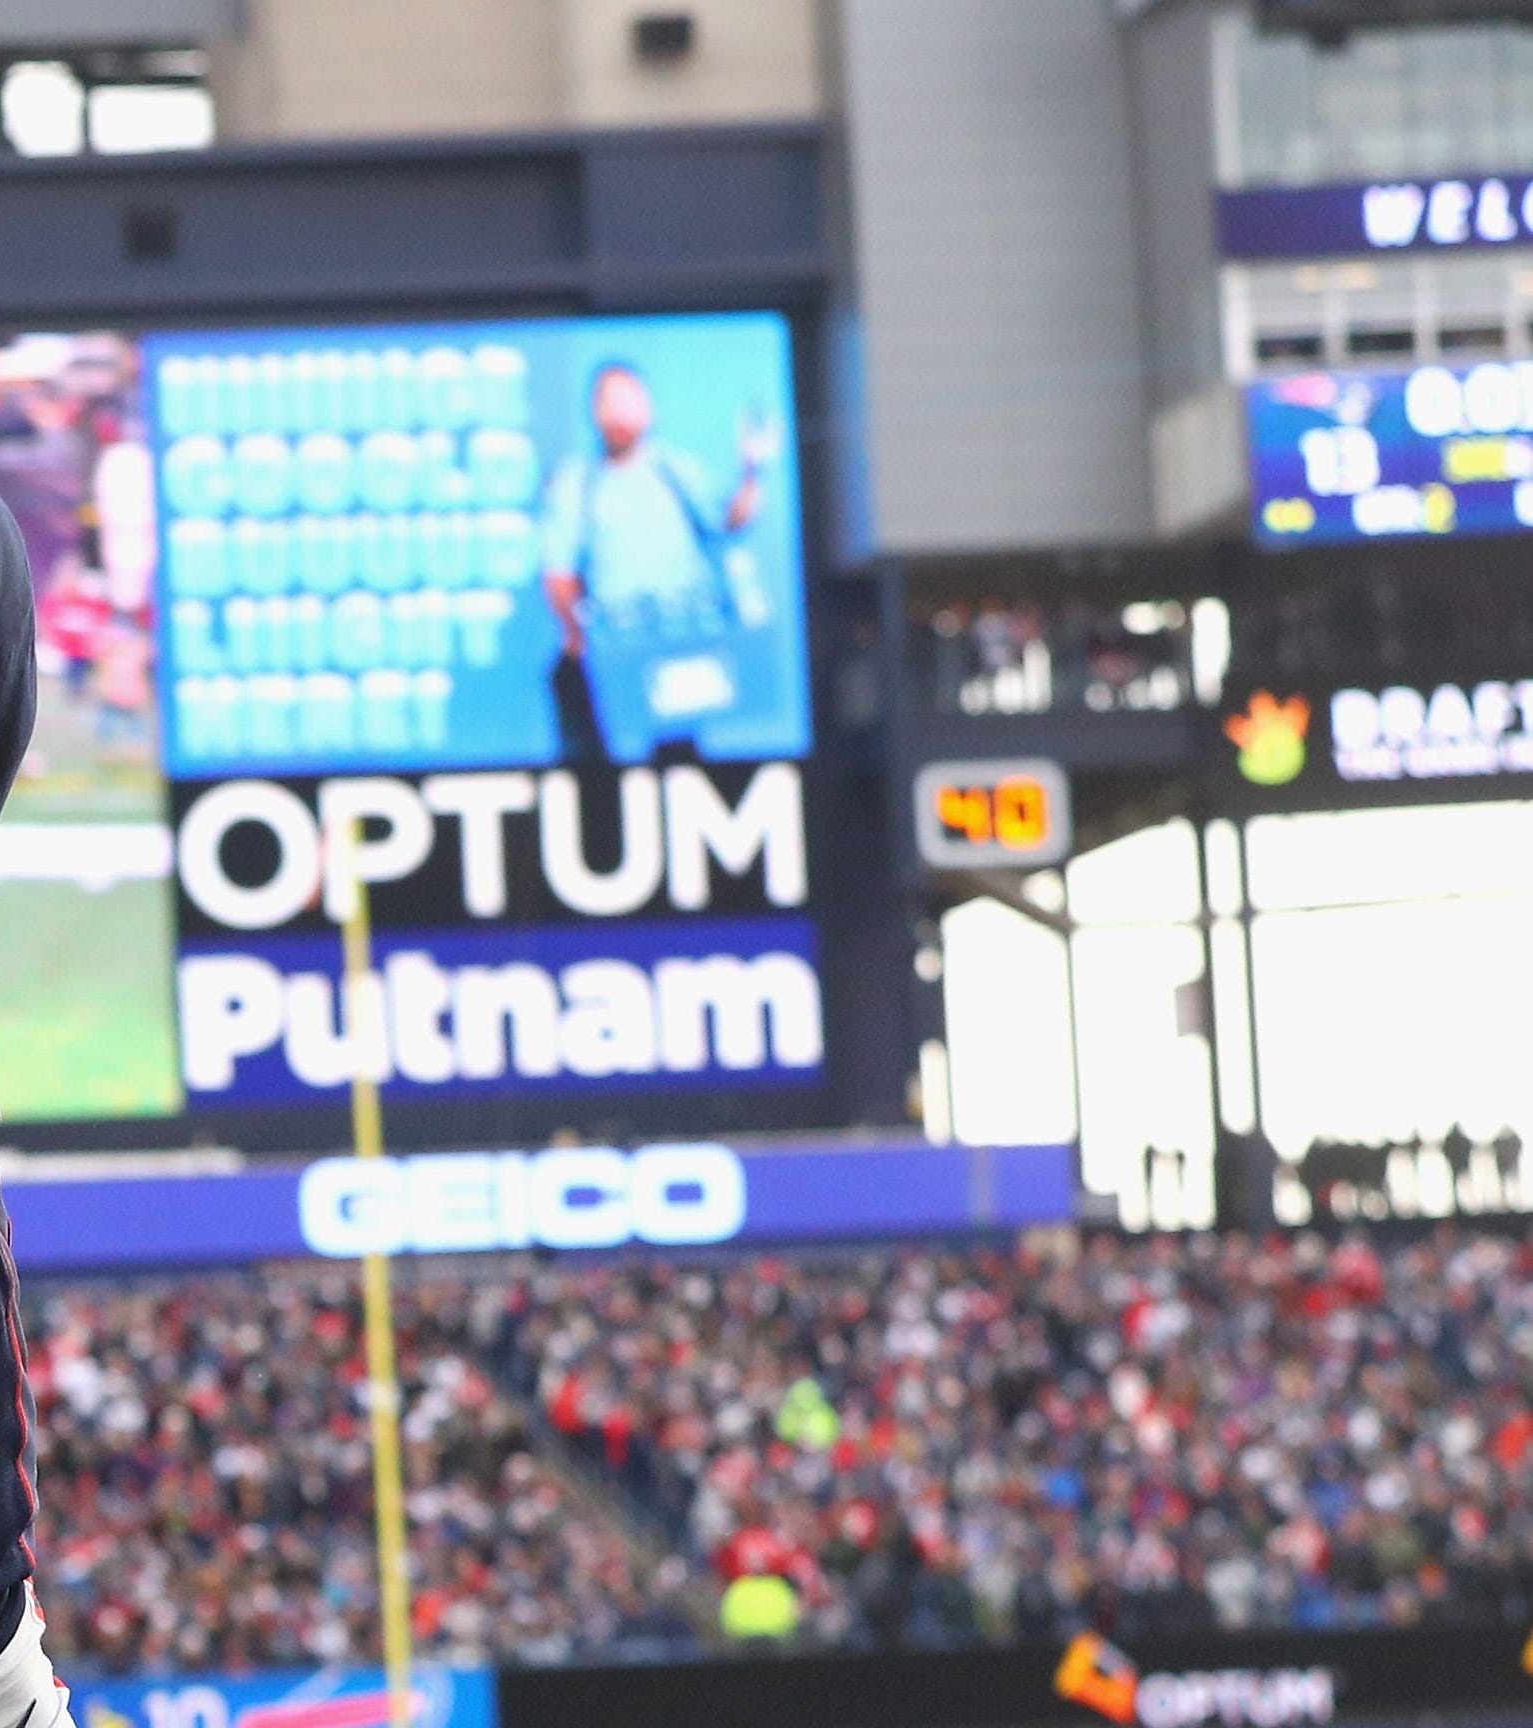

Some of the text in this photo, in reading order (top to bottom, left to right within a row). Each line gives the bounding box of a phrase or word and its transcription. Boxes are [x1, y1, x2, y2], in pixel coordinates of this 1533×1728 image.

[1362, 177, 1533, 247] WEL
[177, 761, 807, 930] OPTUM
[937, 776, 1049, 850] 40
[177, 950, 824, 1092] Putnam
[297, 1141, 746, 1257] GEICO
